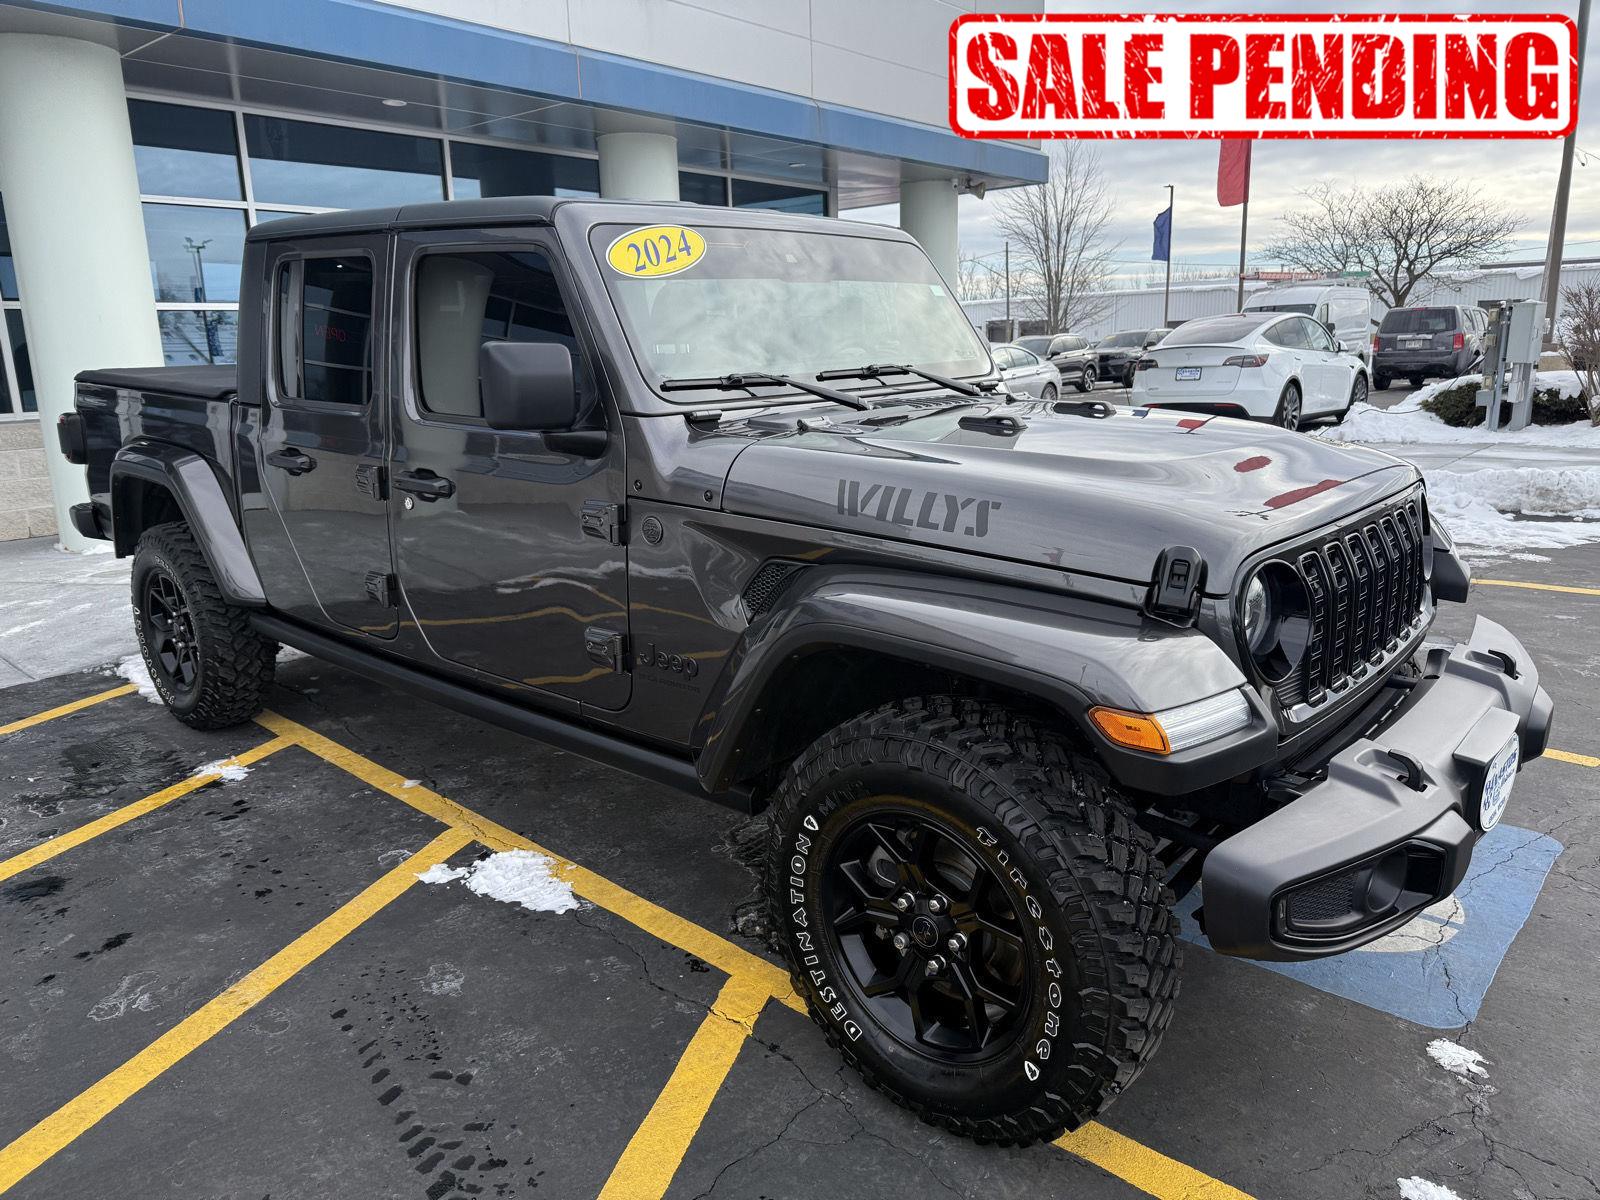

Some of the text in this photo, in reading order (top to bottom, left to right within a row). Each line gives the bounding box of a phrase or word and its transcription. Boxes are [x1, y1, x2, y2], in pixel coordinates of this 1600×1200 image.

[627, 230, 692, 273] 2024
[837, 479, 1002, 538] WILLYS
[639, 642, 699, 681] Jeep
[789, 833, 863, 1042] DESTINATION
